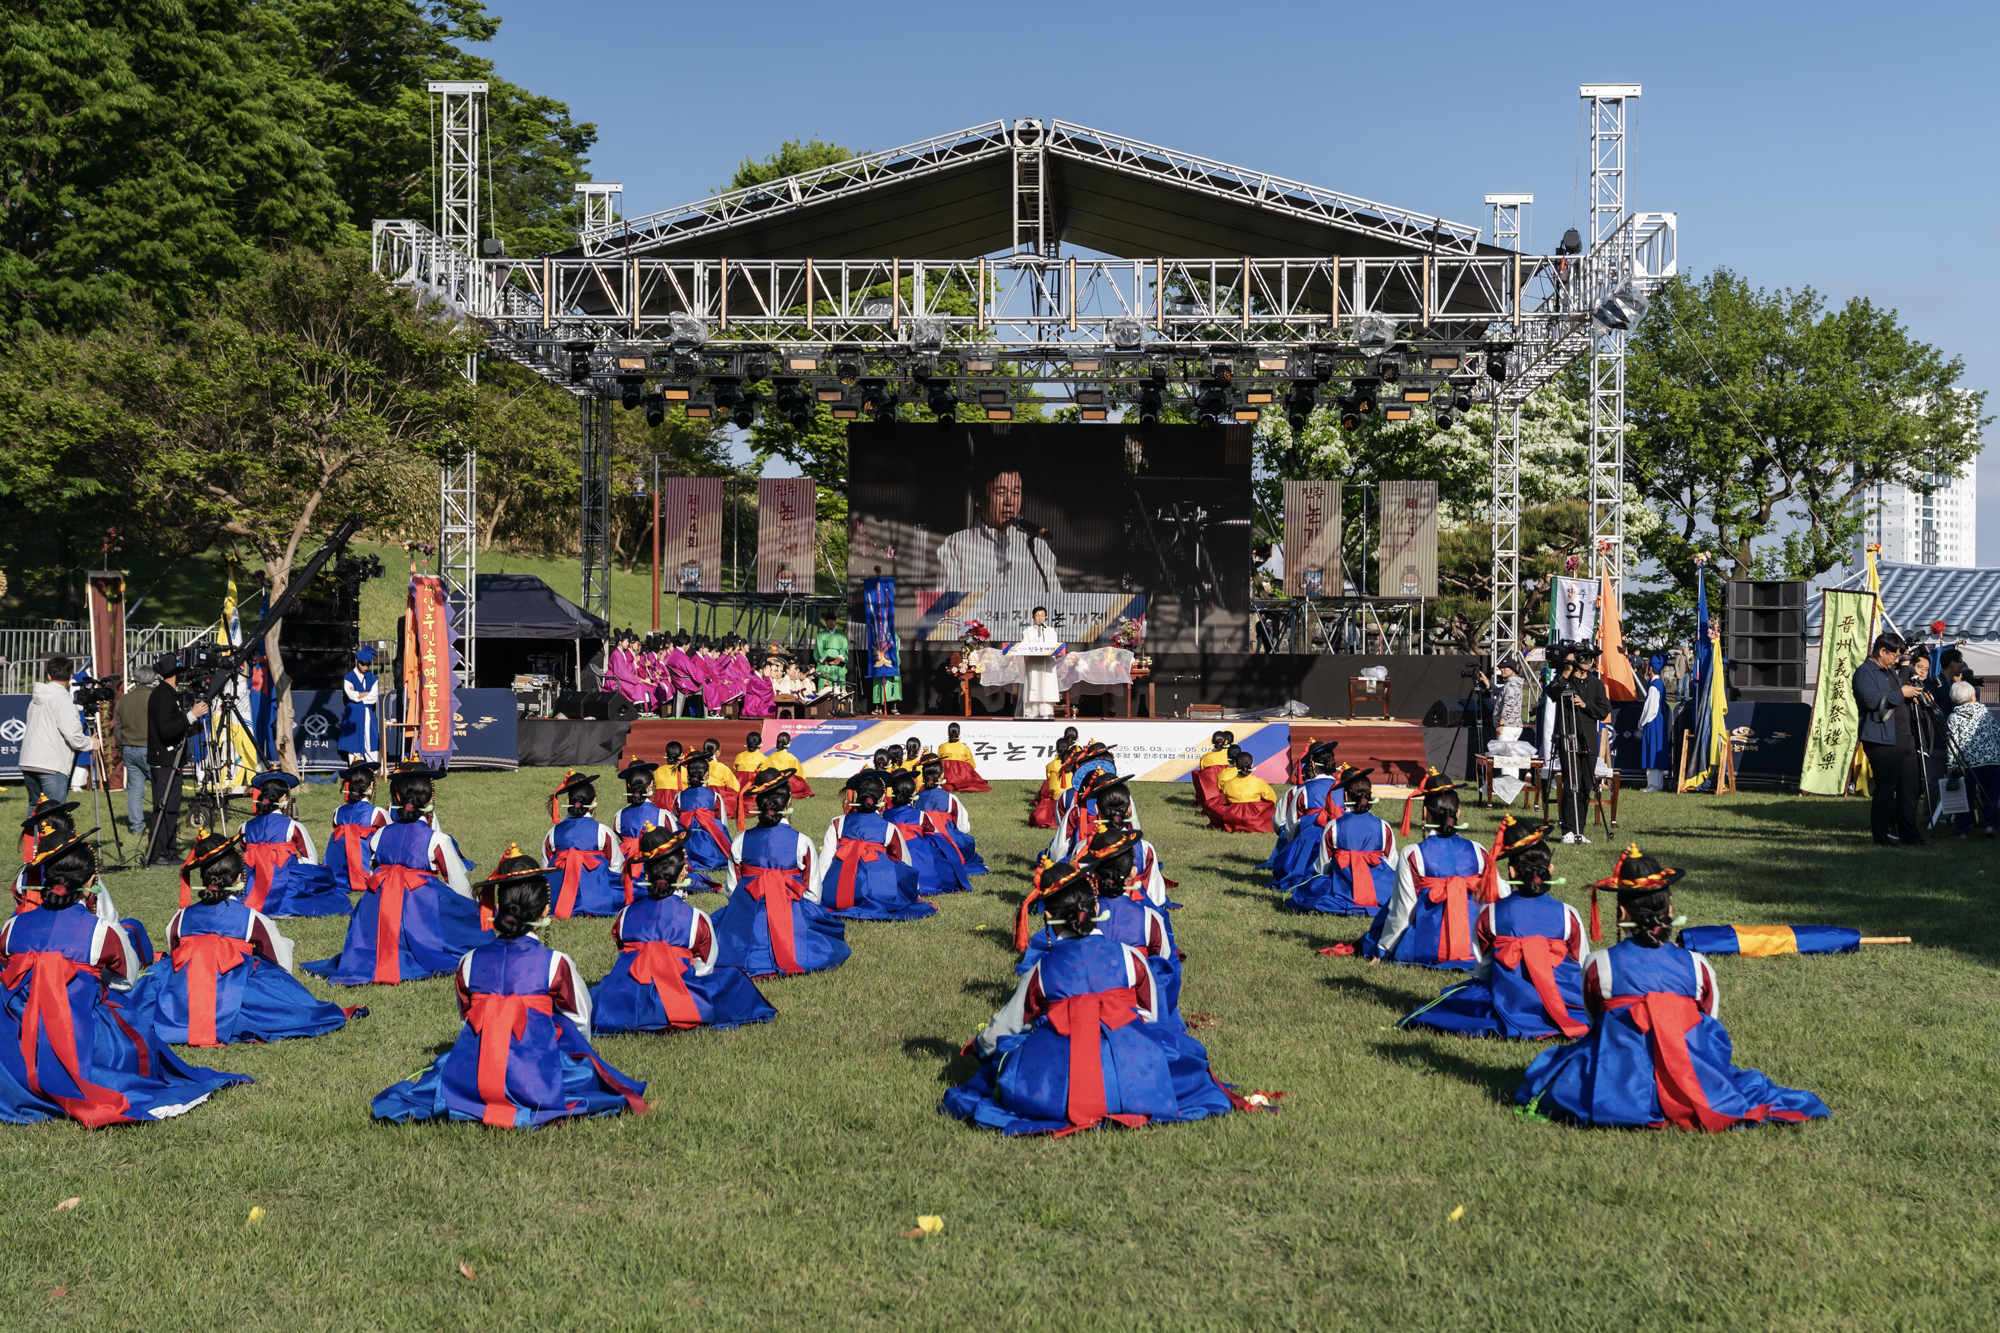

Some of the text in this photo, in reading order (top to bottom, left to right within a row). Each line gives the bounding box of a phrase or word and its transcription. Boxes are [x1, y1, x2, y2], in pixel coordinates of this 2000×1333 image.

[1301, 486, 1324, 499] 진주
[687, 494, 700, 548] 제24회
[304, 740, 329, 749] 진주시
